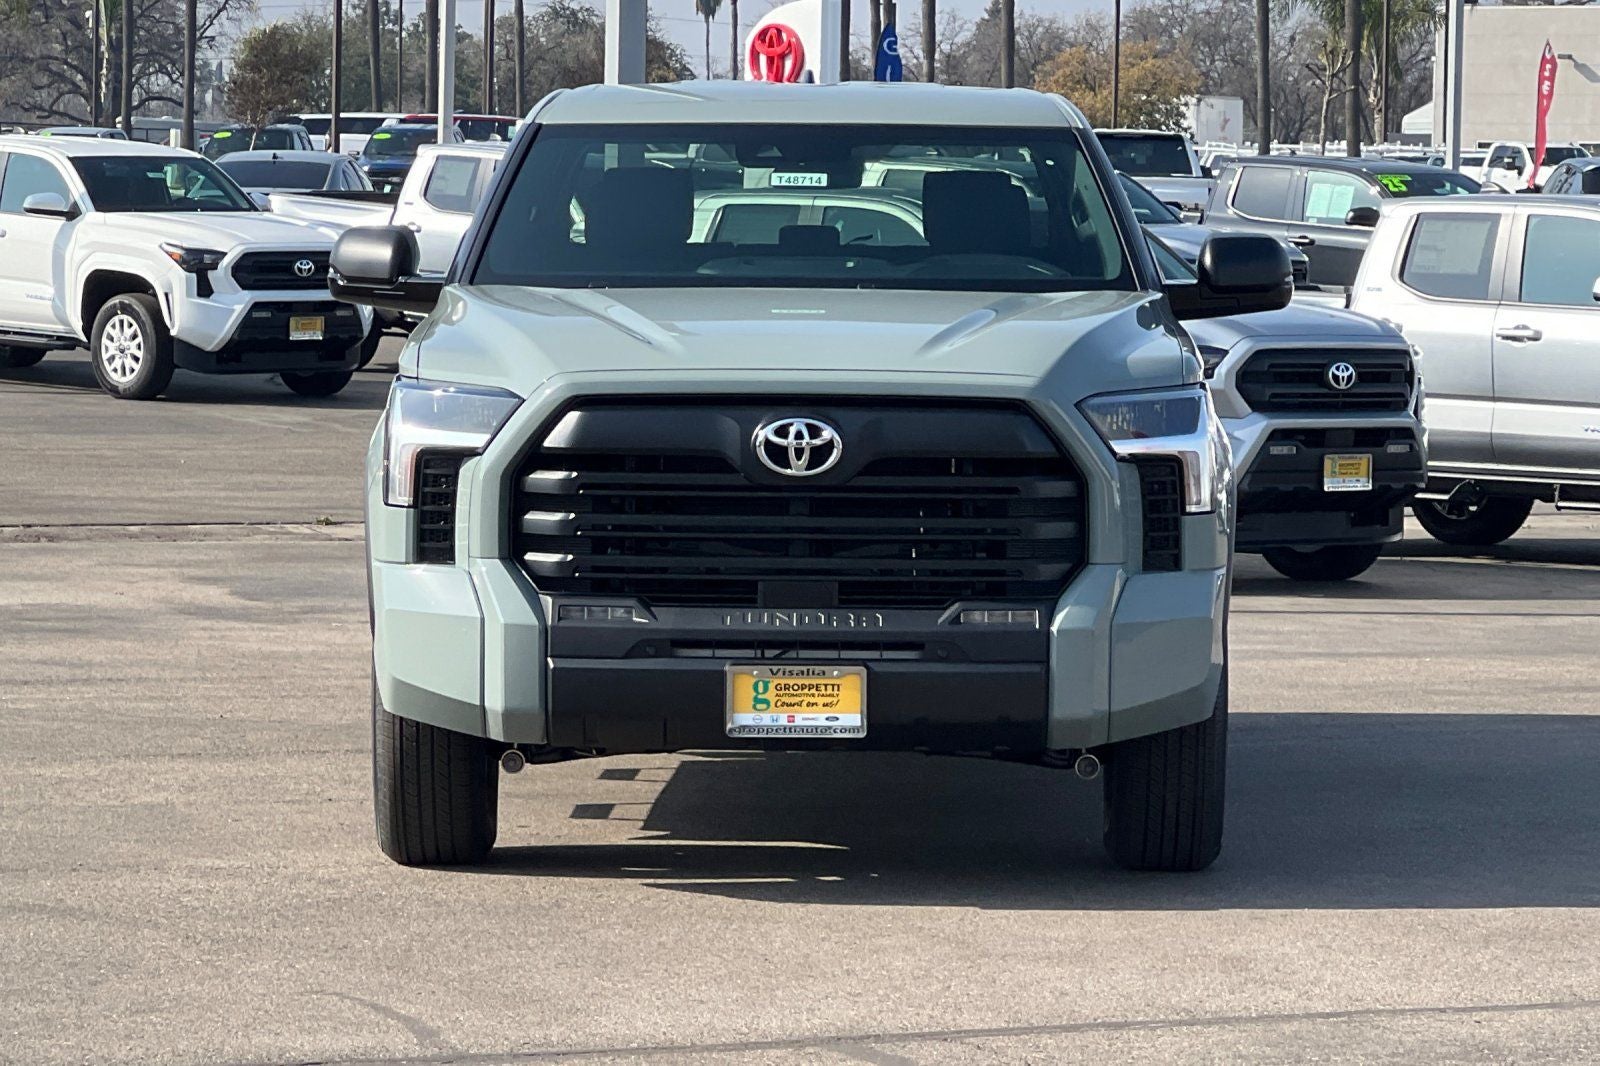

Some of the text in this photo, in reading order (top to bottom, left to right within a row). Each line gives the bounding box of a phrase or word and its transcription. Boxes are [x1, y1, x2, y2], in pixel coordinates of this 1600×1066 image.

[776, 175, 822, 185] T48714
[1381, 177, 1408, 192] 25
[768, 667, 827, 677] Visalia
[774, 683, 840, 692] GROPPETTI
[774, 698, 805, 708] Count
[822, 699, 840, 708] us!
[733, 725, 861, 735] groppettiauto.com
